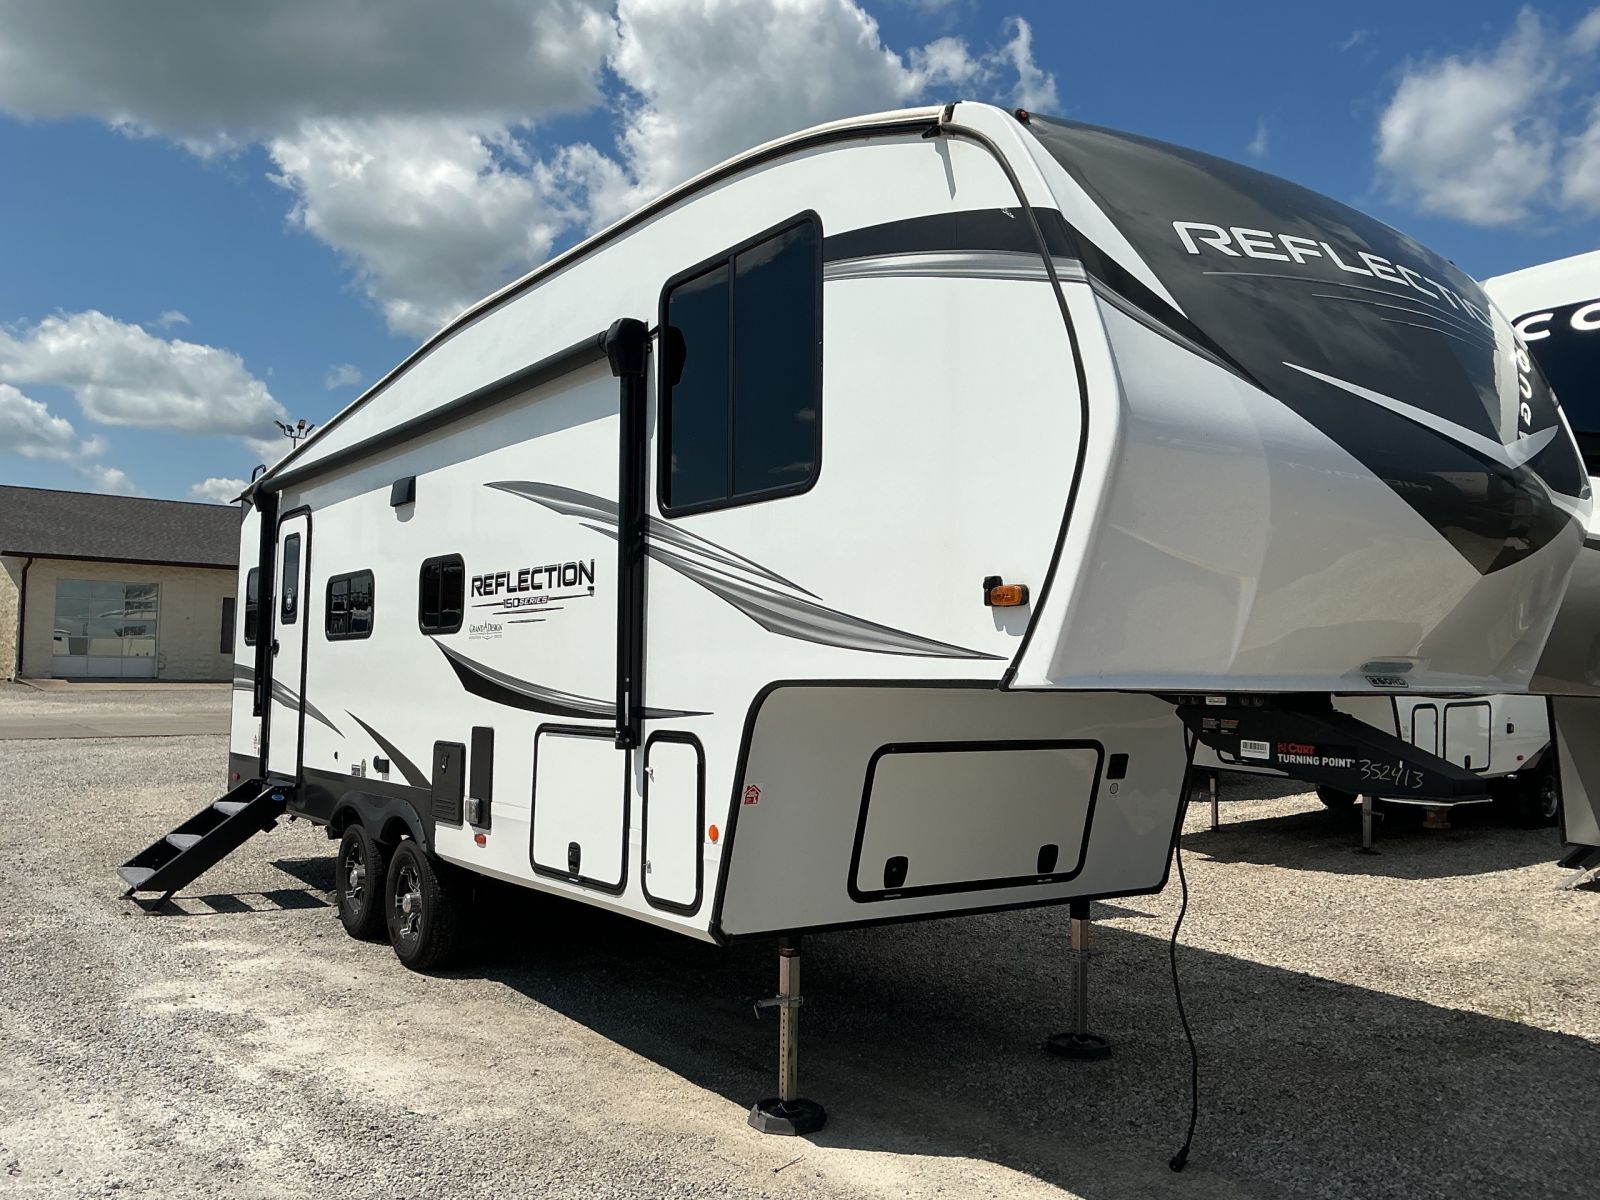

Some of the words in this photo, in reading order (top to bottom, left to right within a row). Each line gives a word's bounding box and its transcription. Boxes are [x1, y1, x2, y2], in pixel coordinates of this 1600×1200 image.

[1172, 220, 1497, 332] REFLECTIO
[471, 559, 595, 597] REFLECTION
[1277, 753, 1319, 766] TURNING
[1288, 744, 1315, 754] CURT
[1360, 759, 1424, 789] 352413
